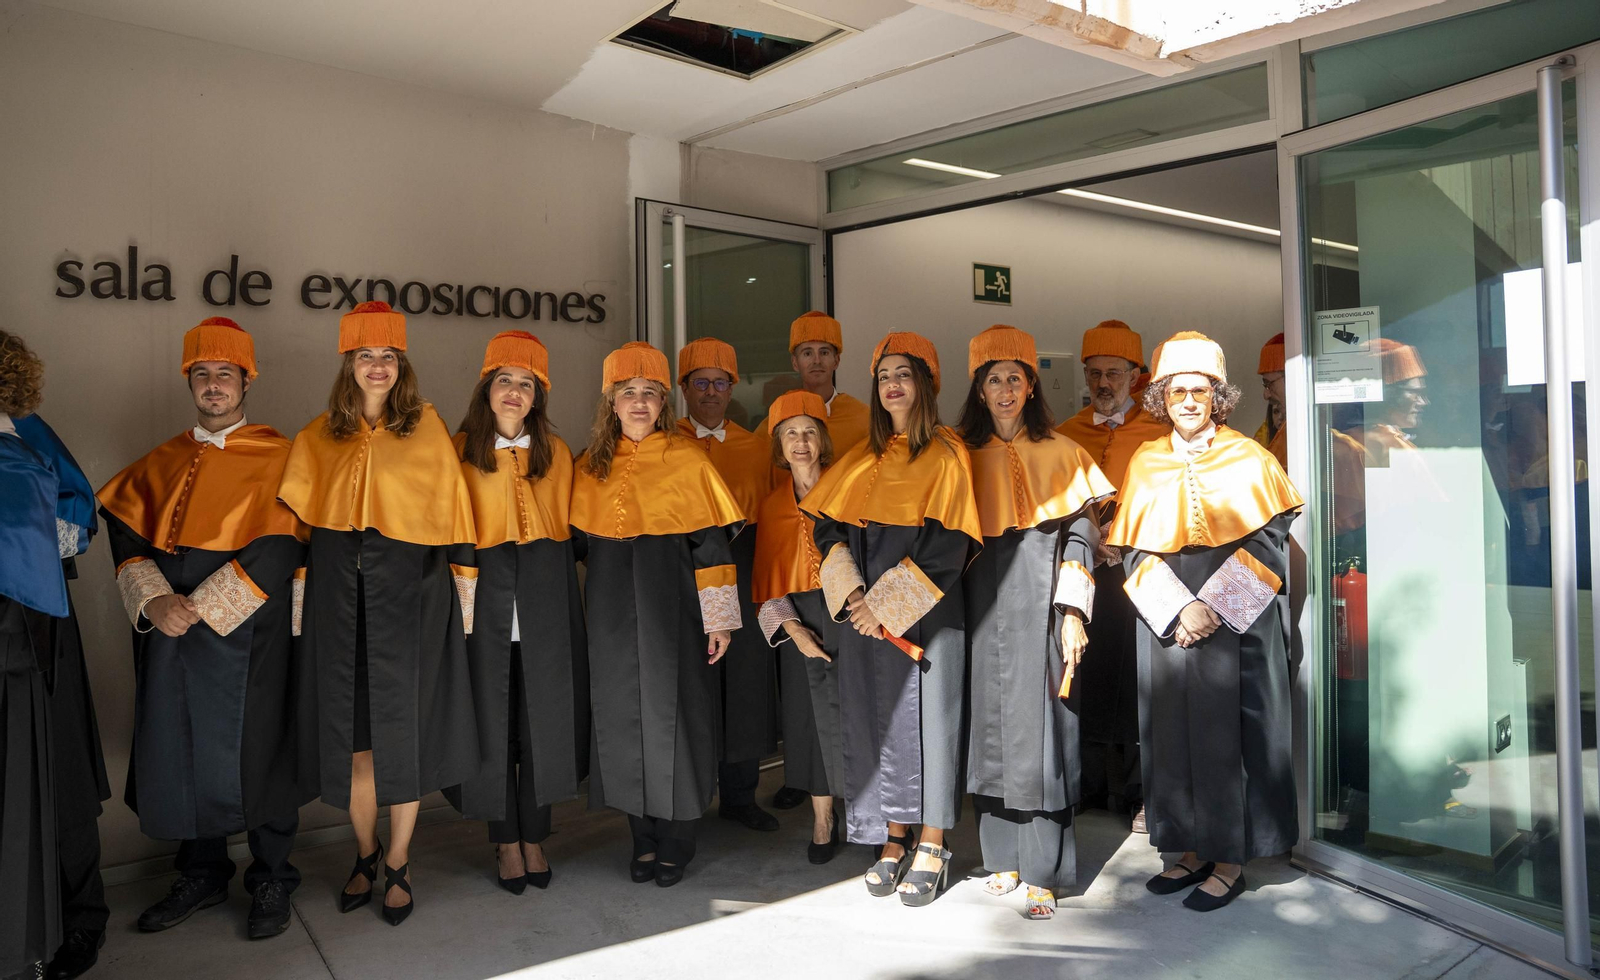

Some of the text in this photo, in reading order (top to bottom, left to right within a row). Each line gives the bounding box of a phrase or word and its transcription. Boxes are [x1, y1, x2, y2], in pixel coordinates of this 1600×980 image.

[56, 246, 607, 324] sala de exposiciones
